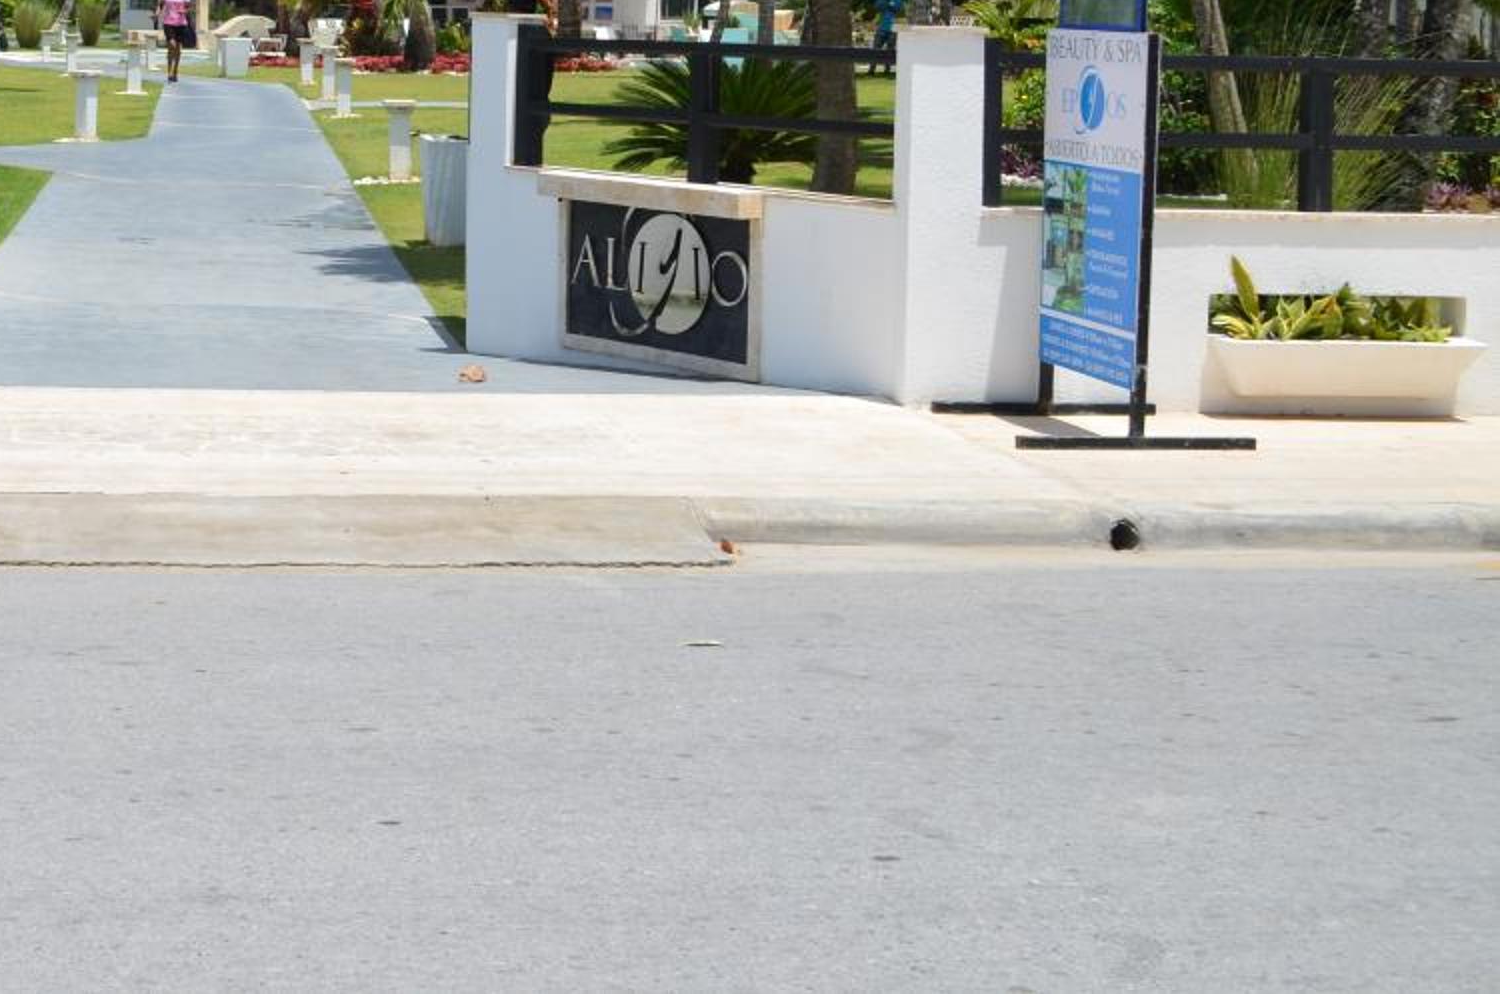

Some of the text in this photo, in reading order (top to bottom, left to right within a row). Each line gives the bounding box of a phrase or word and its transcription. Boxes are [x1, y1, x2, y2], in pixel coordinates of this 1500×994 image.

[1050, 35, 1142, 63] BEAUTY & SPA
